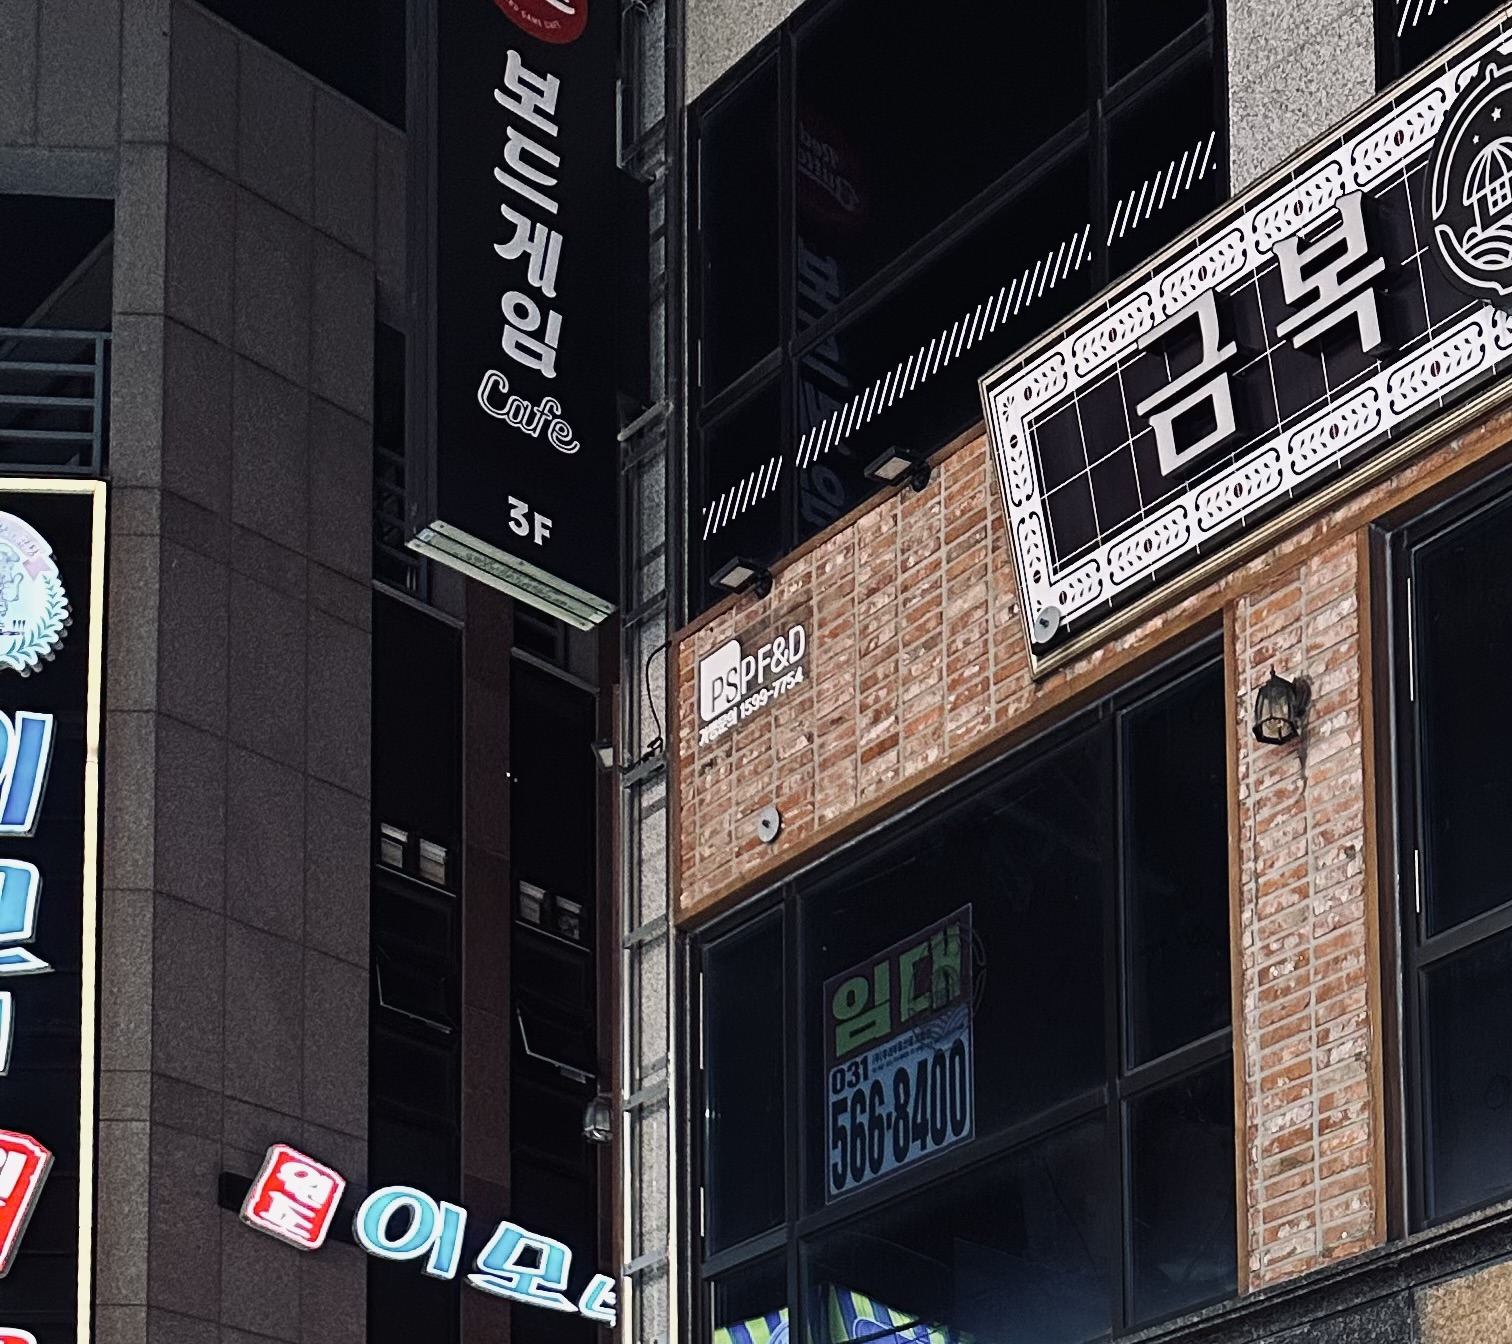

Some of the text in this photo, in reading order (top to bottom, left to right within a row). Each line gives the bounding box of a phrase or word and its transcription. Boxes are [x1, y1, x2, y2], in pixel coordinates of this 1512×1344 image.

[493, 49, 564, 379] 보드게임
[1136, 189, 1386, 477] 금복
[477, 369, 581, 454] Cafe
[508, 495, 553, 546] 3F
[740, 666, 804, 719] 1599-7754
[832, 923, 961, 1057] 임대
[831, 1055, 869, 1095] 031
[831, 1038, 966, 1191] 566-8400
